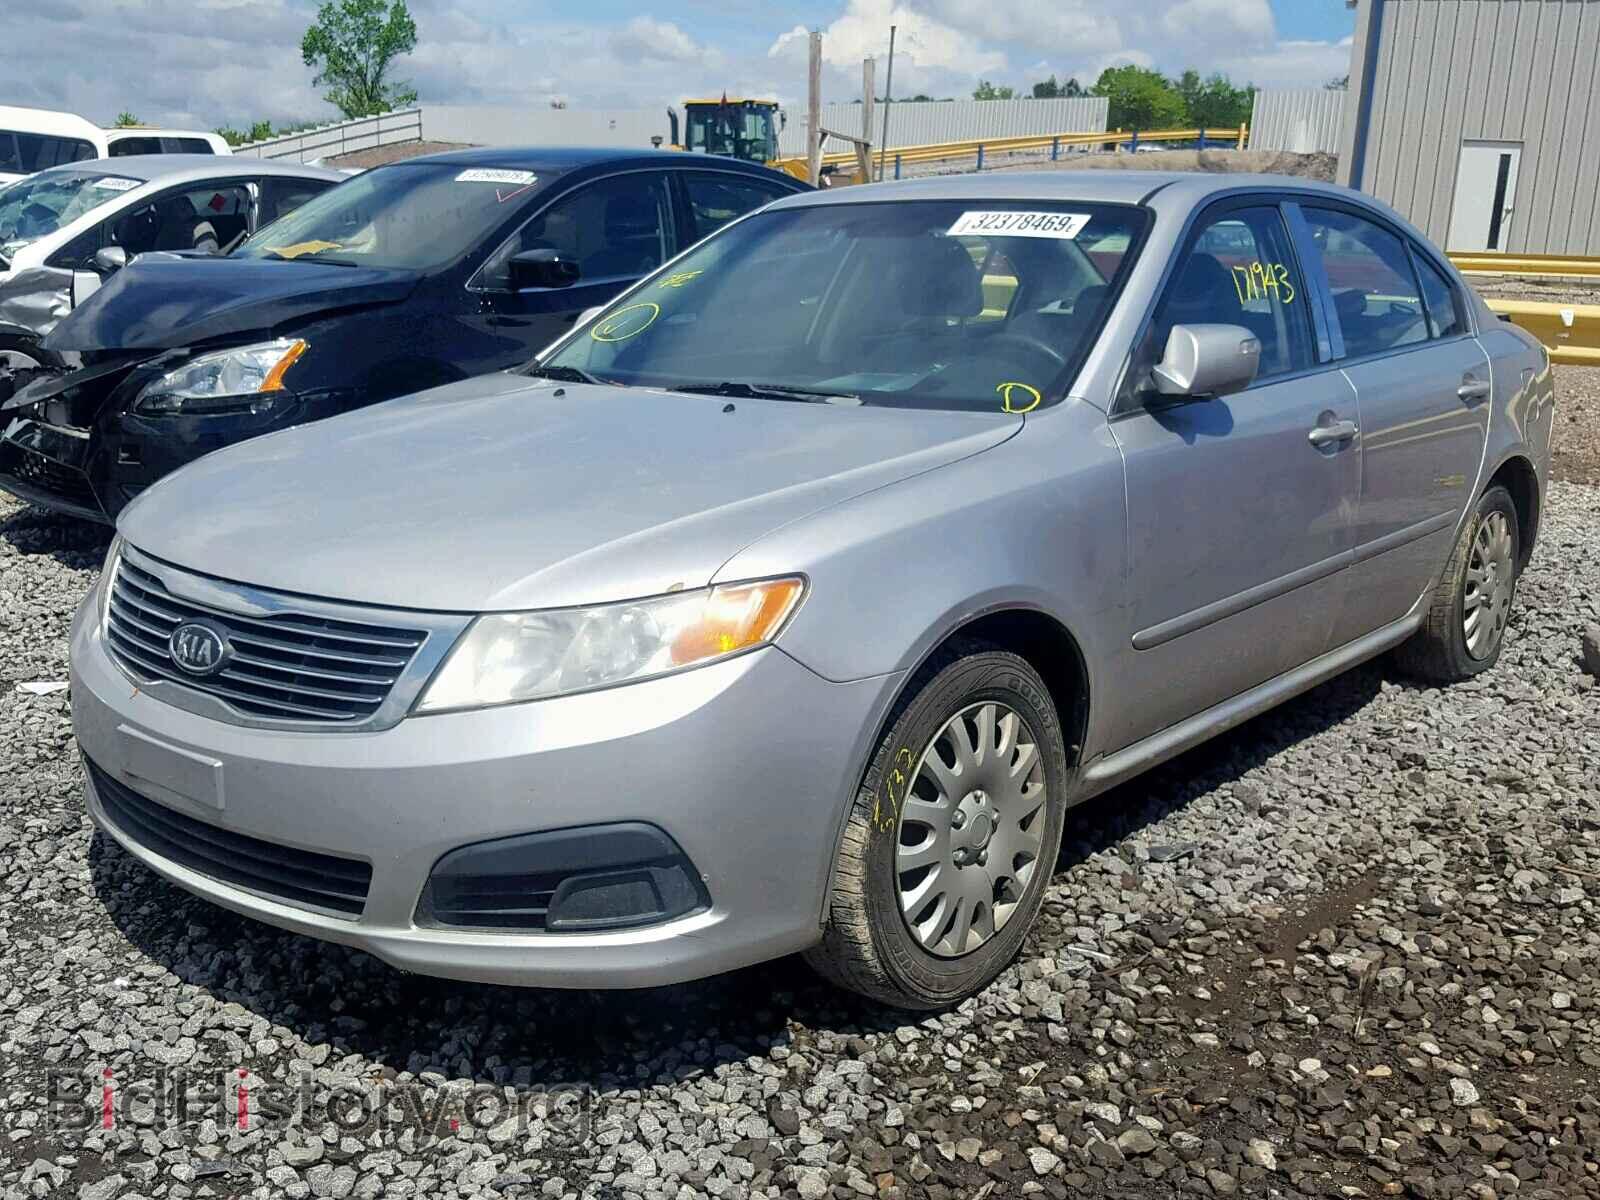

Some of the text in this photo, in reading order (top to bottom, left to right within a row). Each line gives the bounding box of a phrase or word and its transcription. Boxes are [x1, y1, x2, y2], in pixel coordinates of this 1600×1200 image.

[971, 213, 1073, 232] 32378469
[996, 382, 1041, 413] D
[176, 629, 212, 664] KIA
